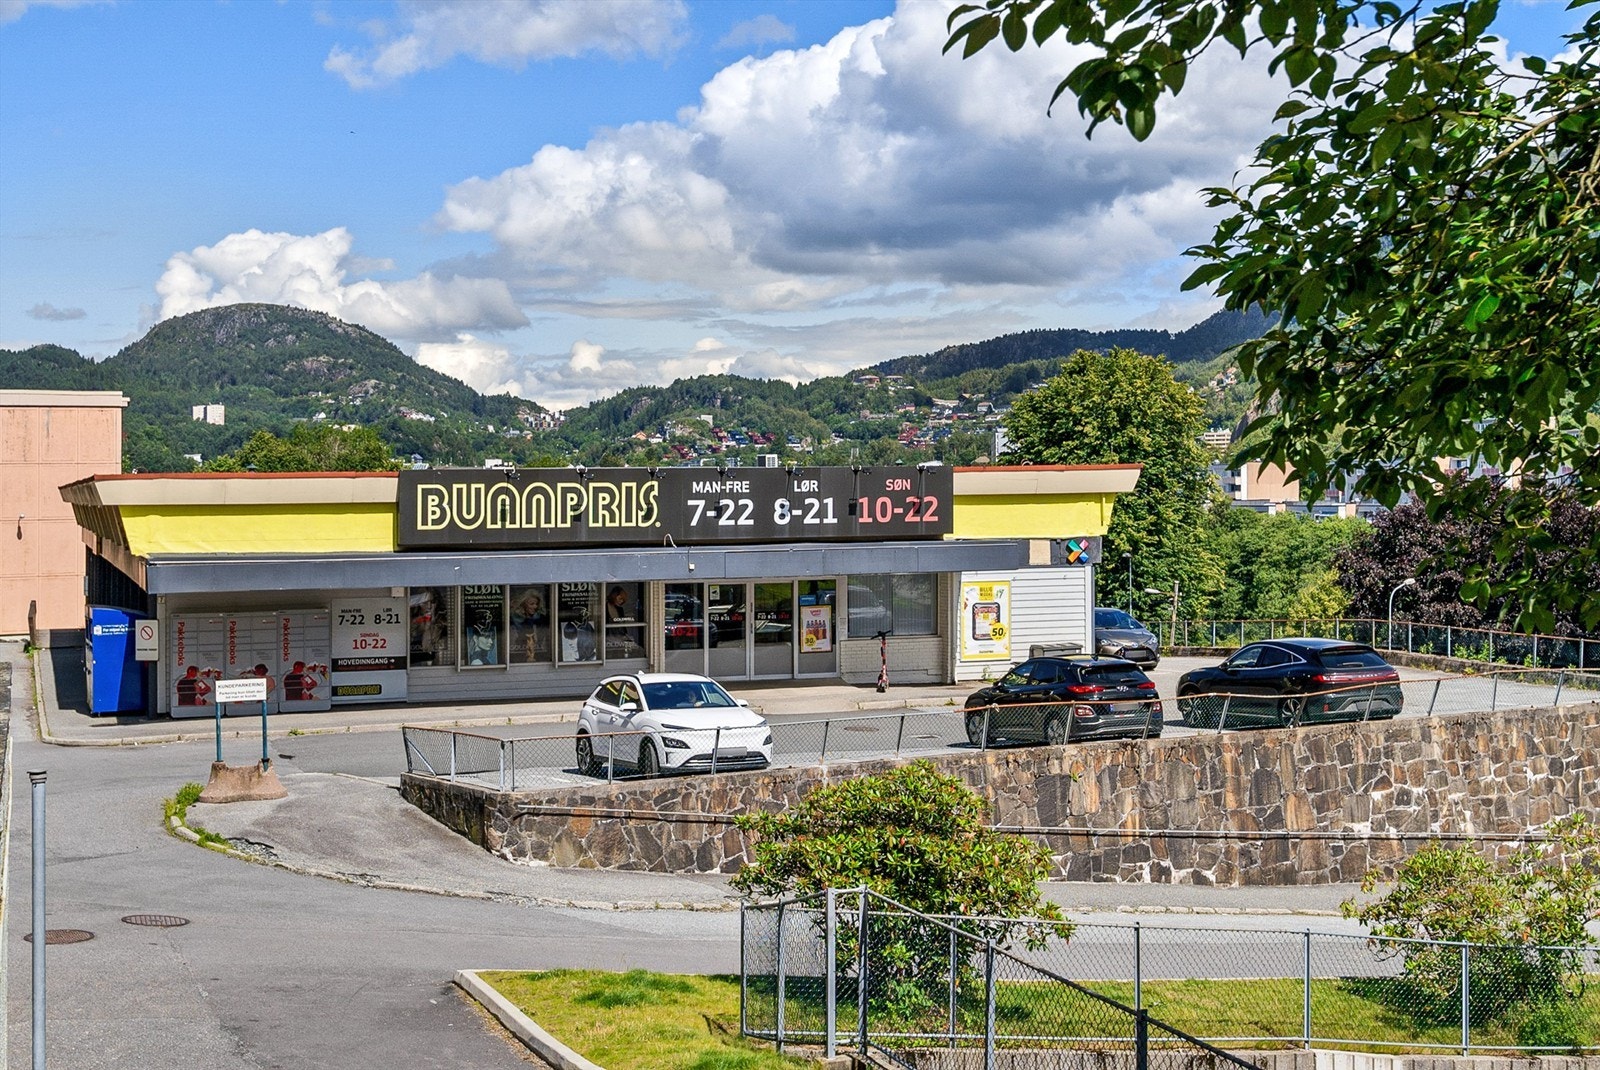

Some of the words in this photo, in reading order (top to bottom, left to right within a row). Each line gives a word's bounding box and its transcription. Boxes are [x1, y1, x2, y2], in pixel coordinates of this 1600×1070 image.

[692, 480, 750, 493] MAN-FRE
[793, 479, 819, 492] LØR
[885, 478, 911, 491] SØN
[687, 499, 755, 527] 7-22
[773, 497, 838, 525] 8-21
[858, 496, 939, 523] 10-22
[338, 614, 365, 625] 7-22
[374, 614, 401, 624] 8-21
[229, 620, 237, 665] Pakkeboks
[352, 639, 387, 650] 10-22
[338, 657, 388, 666] HOVEDINNGANG
